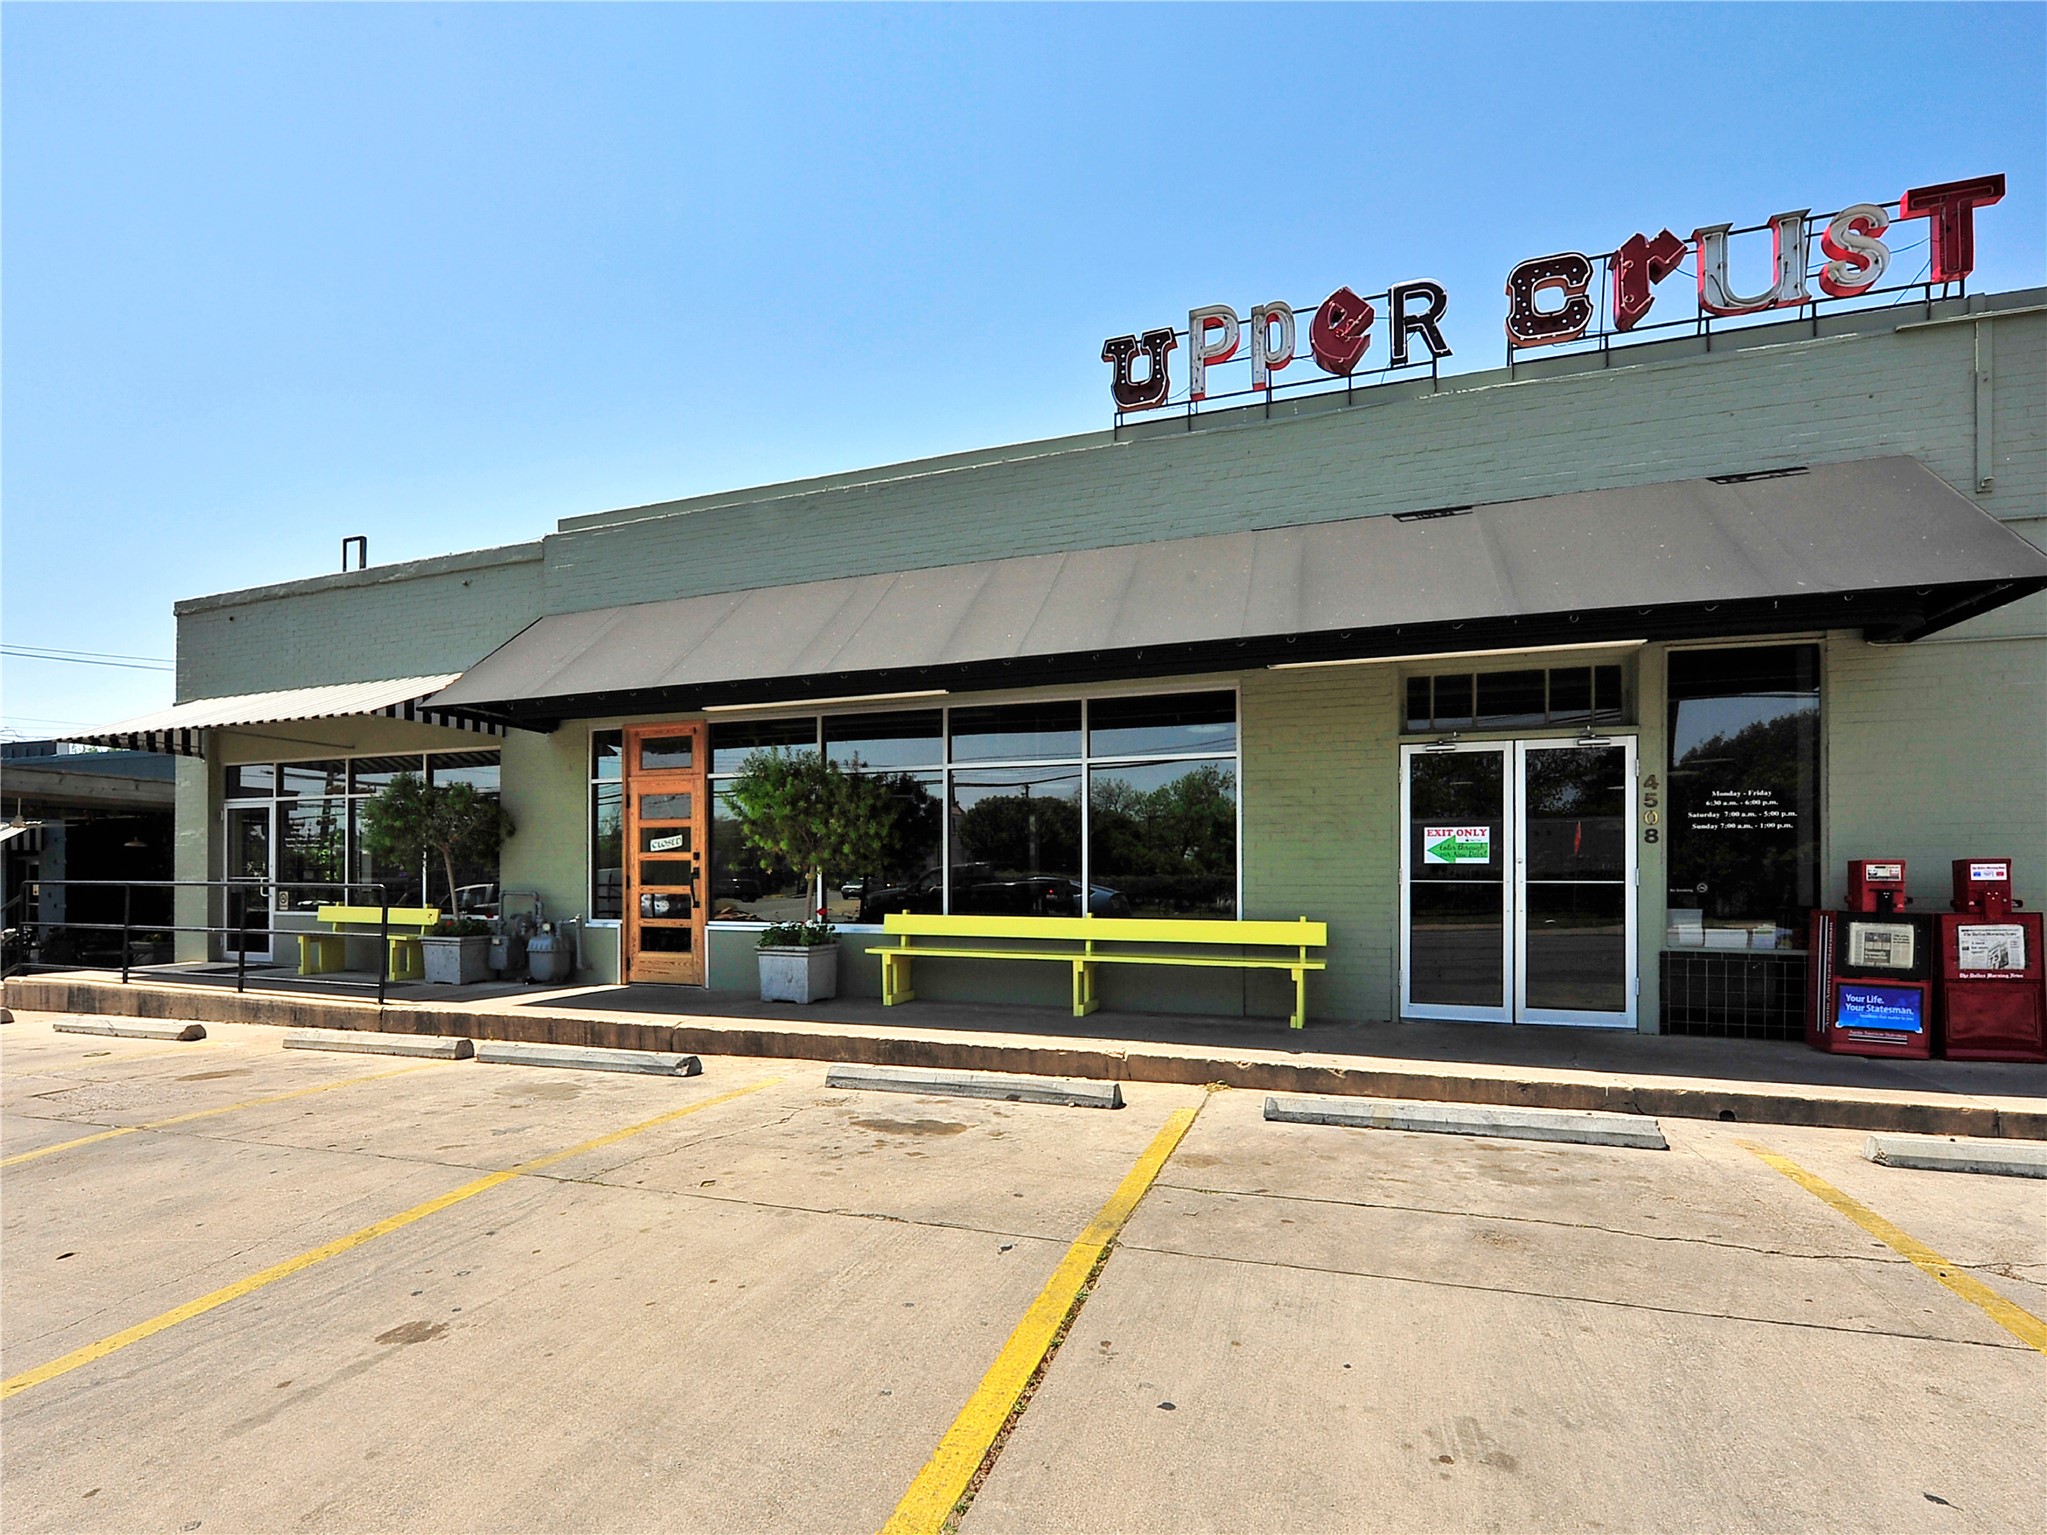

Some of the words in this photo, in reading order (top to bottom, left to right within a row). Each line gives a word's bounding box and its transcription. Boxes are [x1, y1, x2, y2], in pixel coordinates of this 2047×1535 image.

[1711, 790, 1741, 798] Monday
[1748, 789, 1772, 797] Friday
[1643, 774, 1659, 844] 4508
[1687, 811, 1720, 819] Saturday
[1691, 823, 1719, 831] Sunday
[1427, 829, 1454, 837] EXIT
[1456, 829, 1487, 837] ONLY
[651, 837, 682, 849] CLOSED
[1845, 994, 1865, 1002] Your
[1866, 995, 1885, 1004] Life.
[1845, 1003, 1865, 1012] Your
[1866, 1004, 1914, 1015] Statesman.
